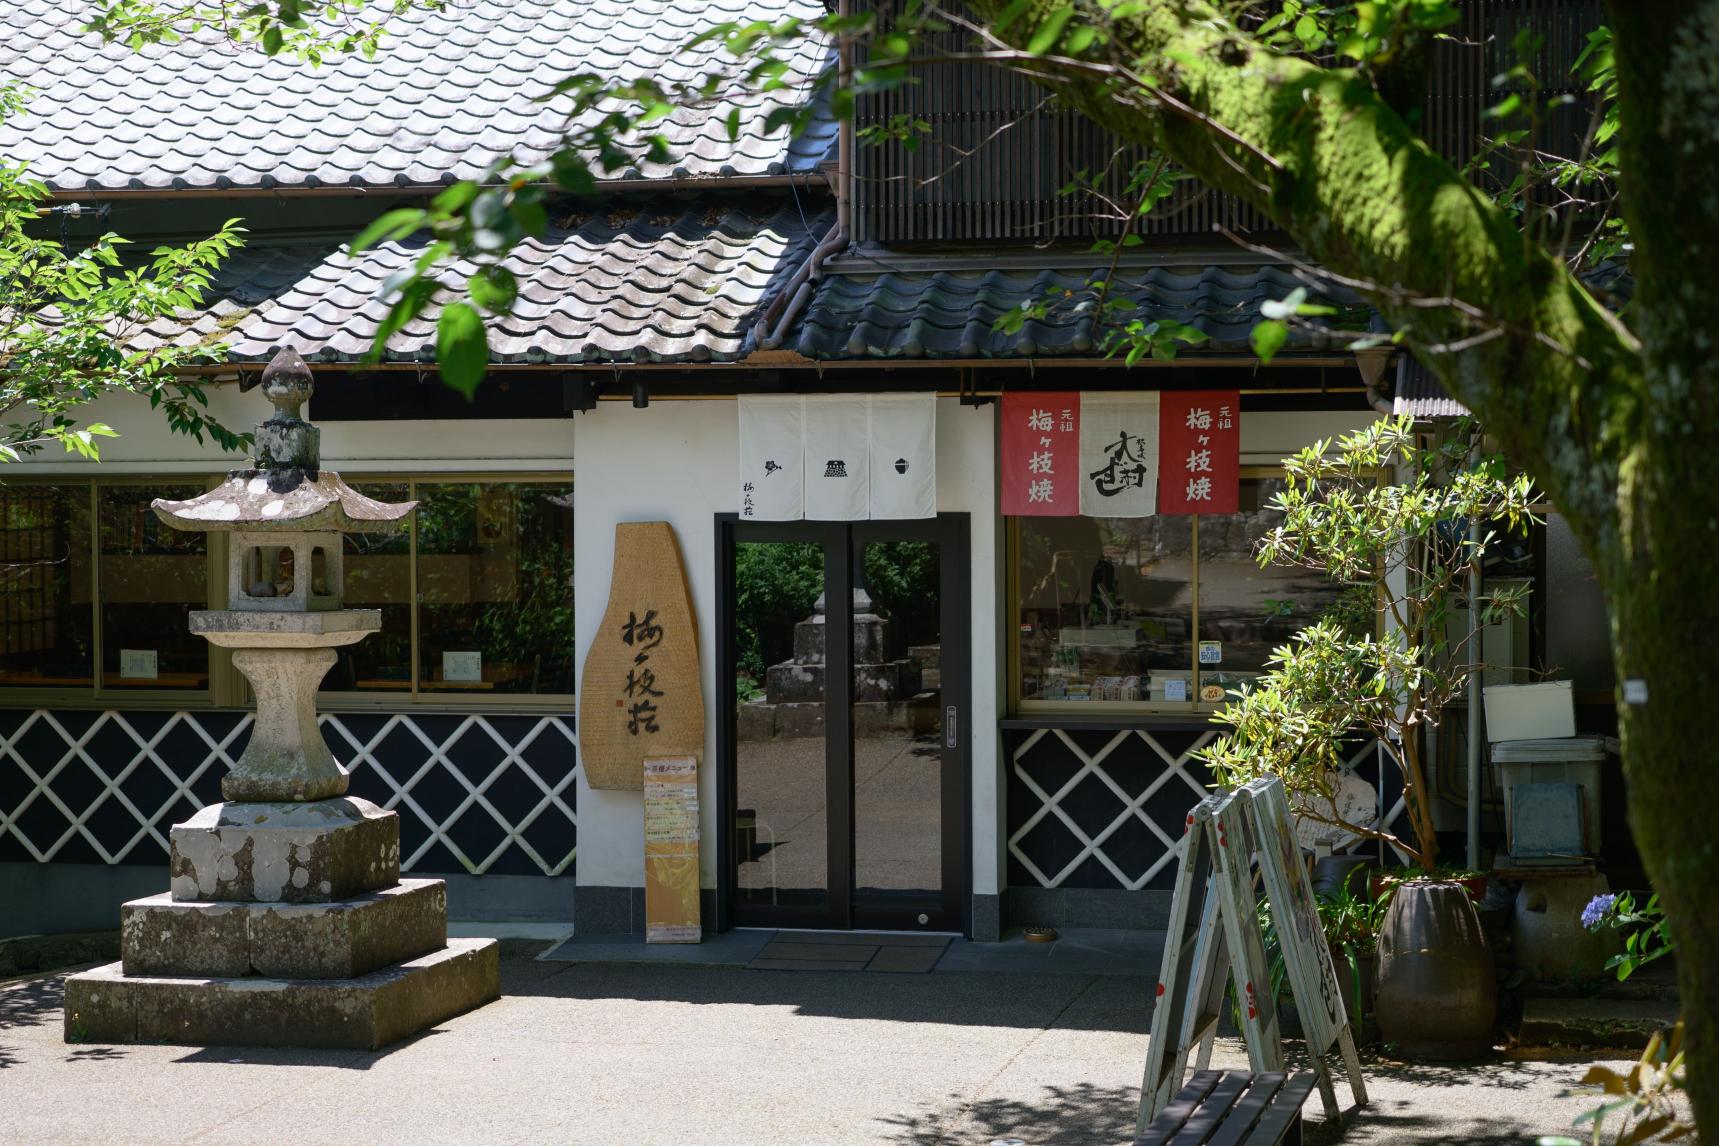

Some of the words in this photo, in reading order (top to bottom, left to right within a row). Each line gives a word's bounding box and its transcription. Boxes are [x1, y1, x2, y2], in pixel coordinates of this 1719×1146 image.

[1060, 409, 1074, 432] 元祖
[1218, 406, 1232, 430] 元祖
[1028, 409, 1055, 502] 梅ヶ枝焼
[1186, 407, 1213, 501] 梅ヶ枝焼
